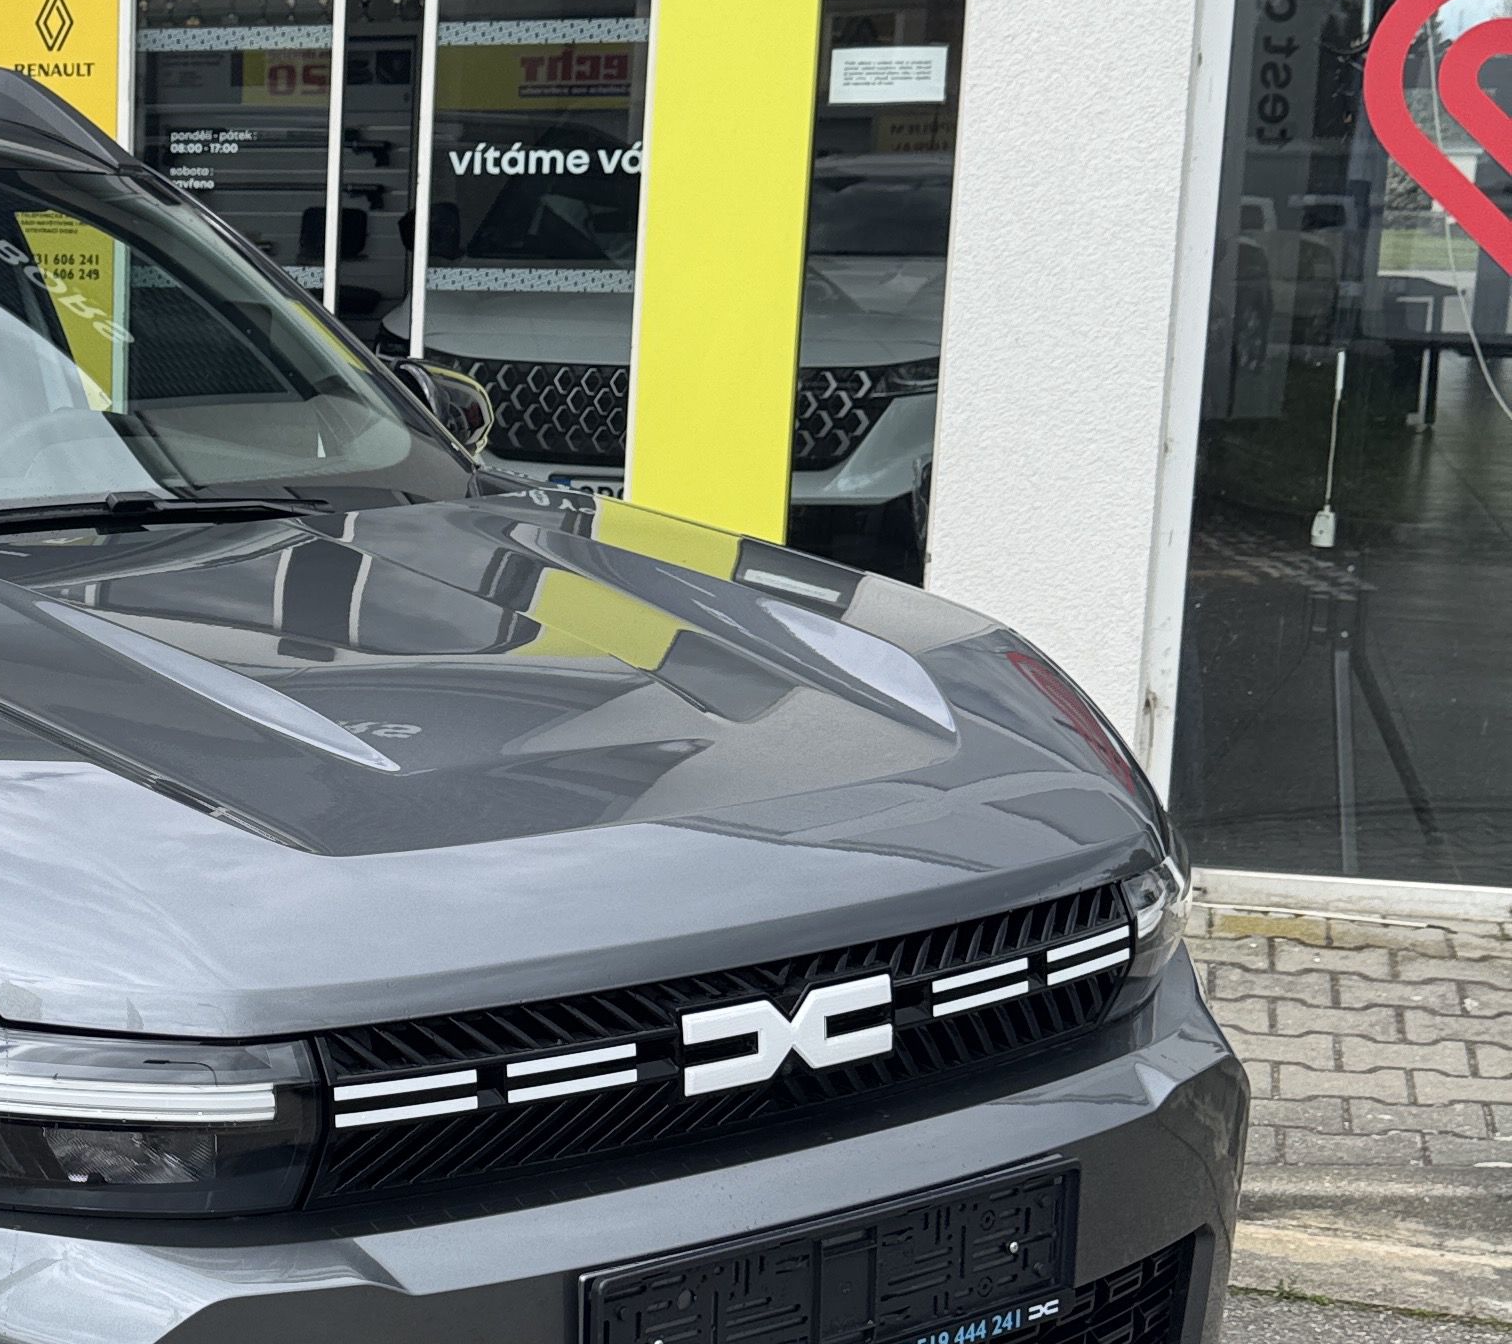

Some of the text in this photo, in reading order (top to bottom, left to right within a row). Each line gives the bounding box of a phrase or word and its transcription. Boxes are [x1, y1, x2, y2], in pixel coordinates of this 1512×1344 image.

[14, 62, 95, 77] RENAULT
[449, 141, 644, 175] vítáme vá
[33, 254, 100, 265] 31 606 241
[991, 1308, 1021, 1336] 241
